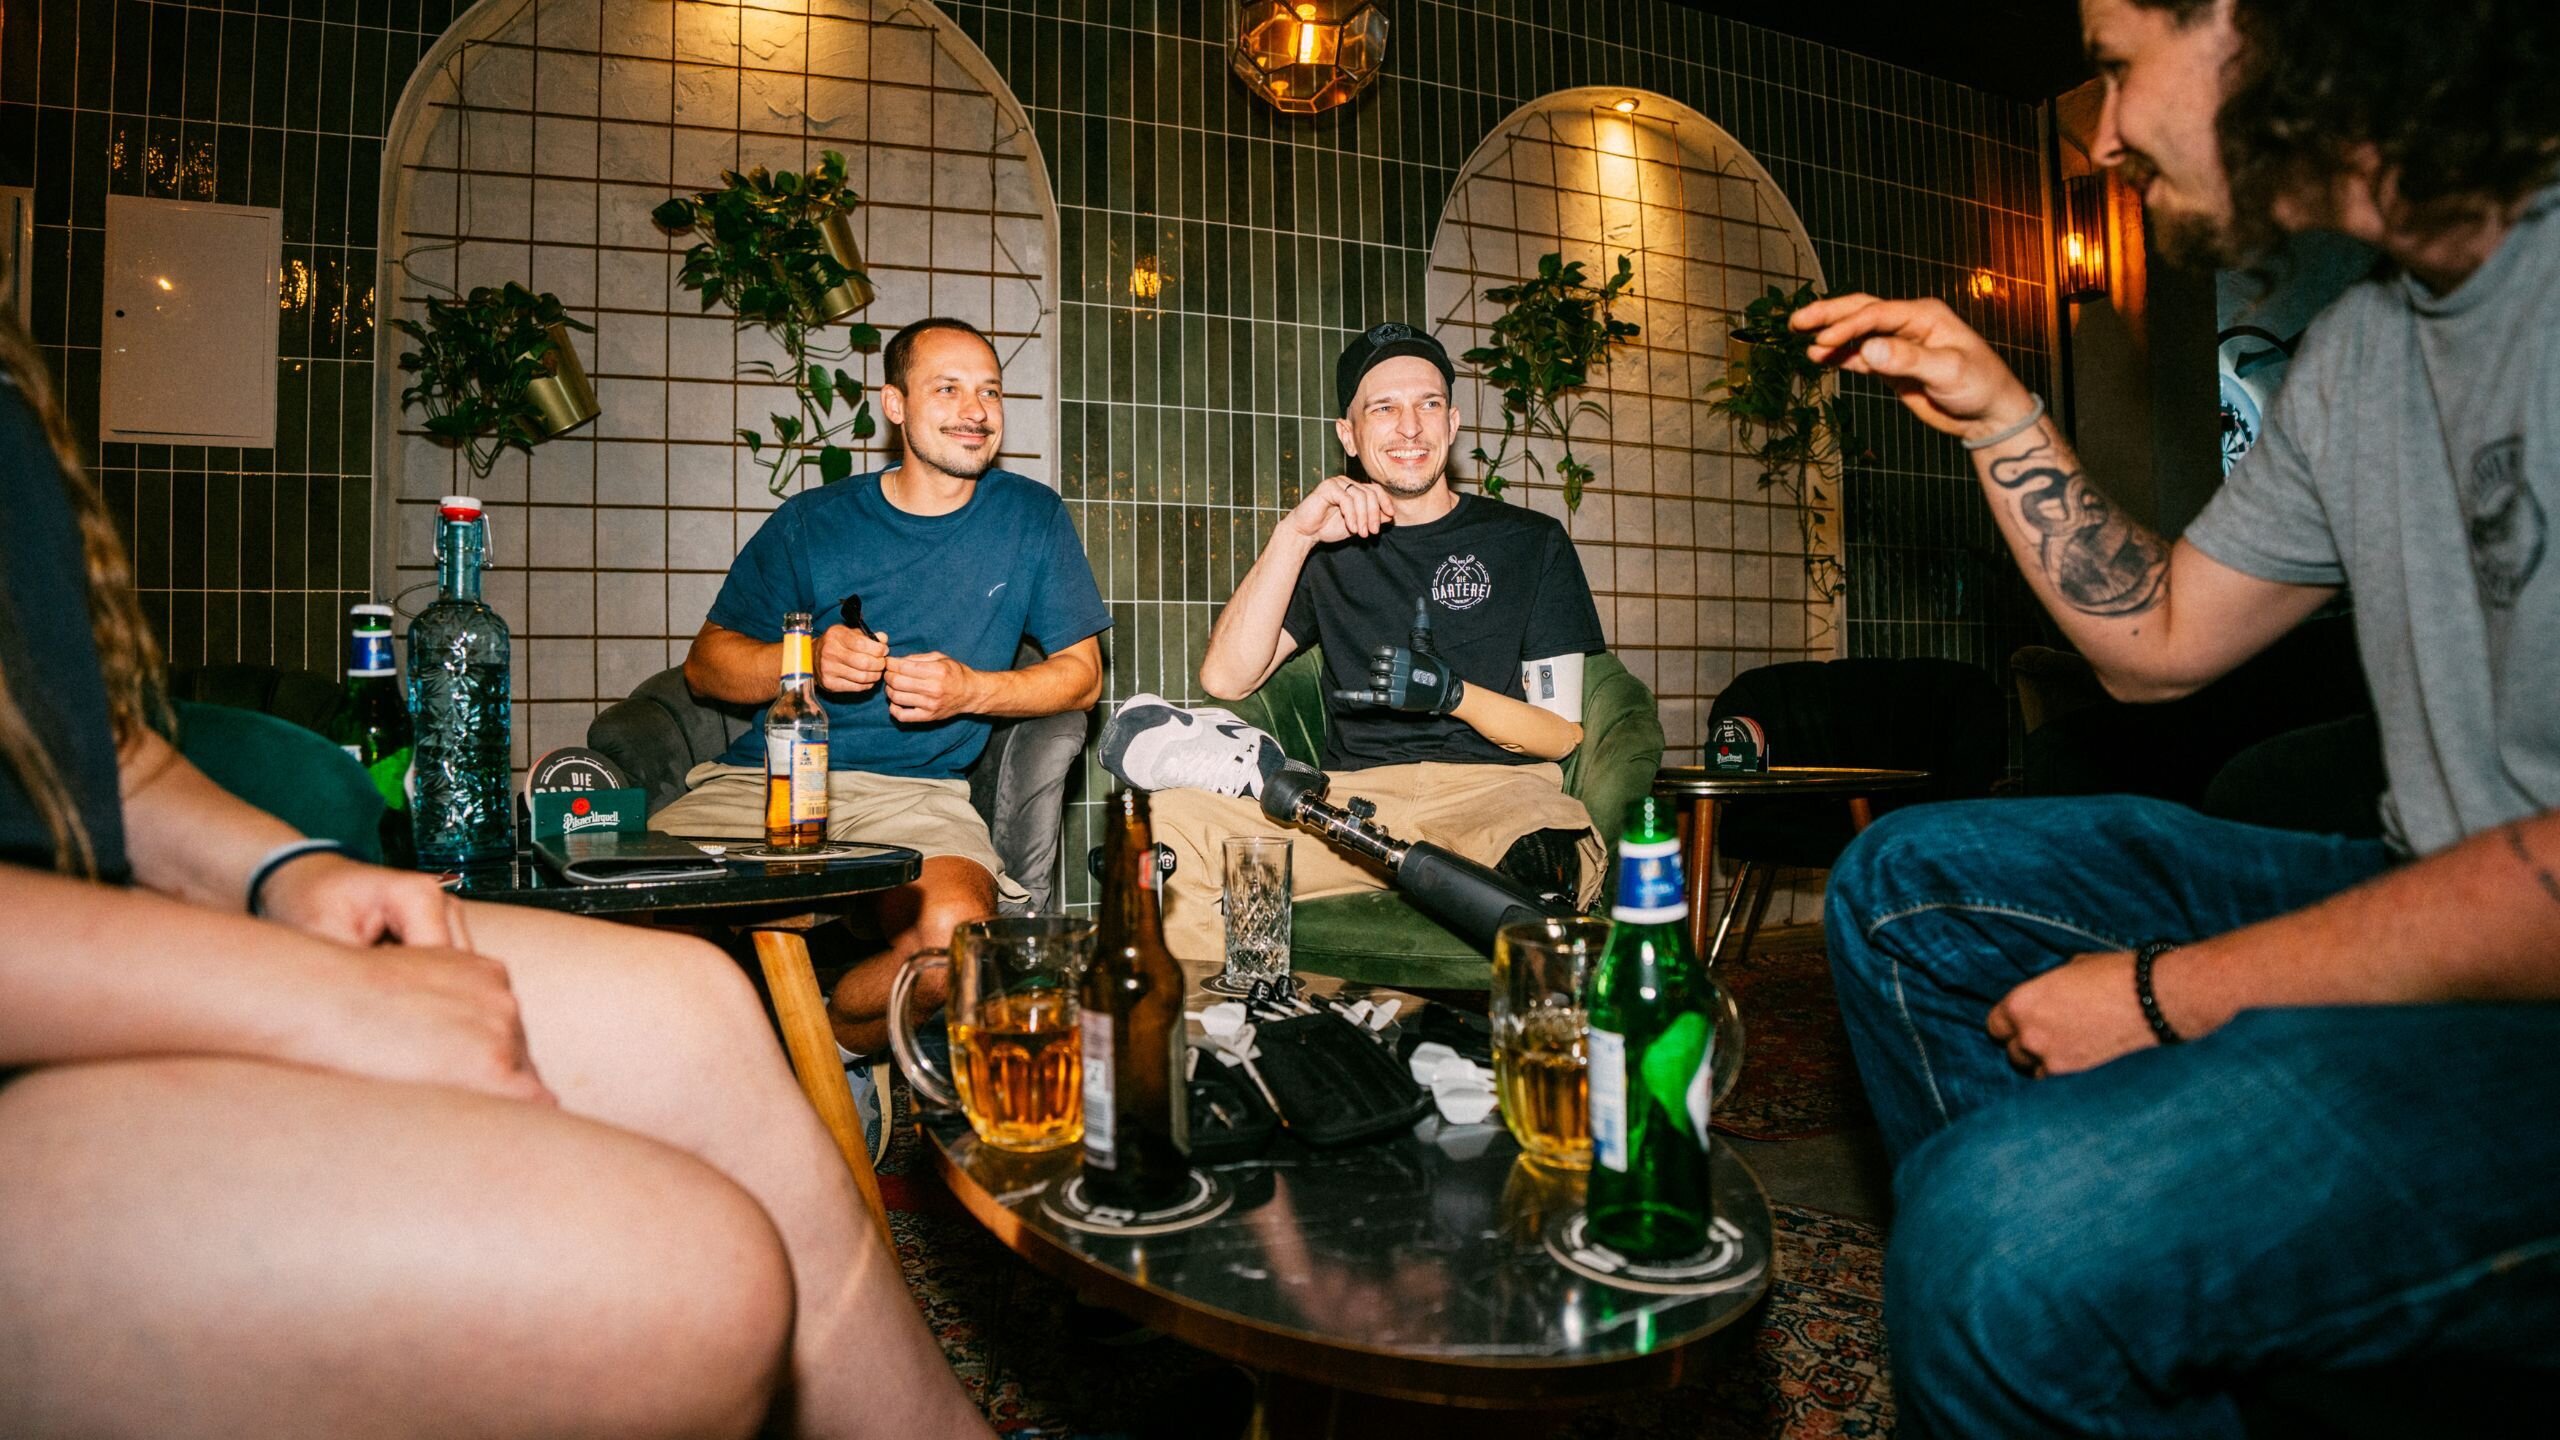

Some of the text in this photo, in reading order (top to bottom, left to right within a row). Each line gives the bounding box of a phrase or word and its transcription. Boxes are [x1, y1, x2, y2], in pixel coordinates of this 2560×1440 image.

[1456, 575, 1467, 583] DIE
[1431, 583, 1492, 601] DARTEREI
[571, 772, 592, 787] DIE
